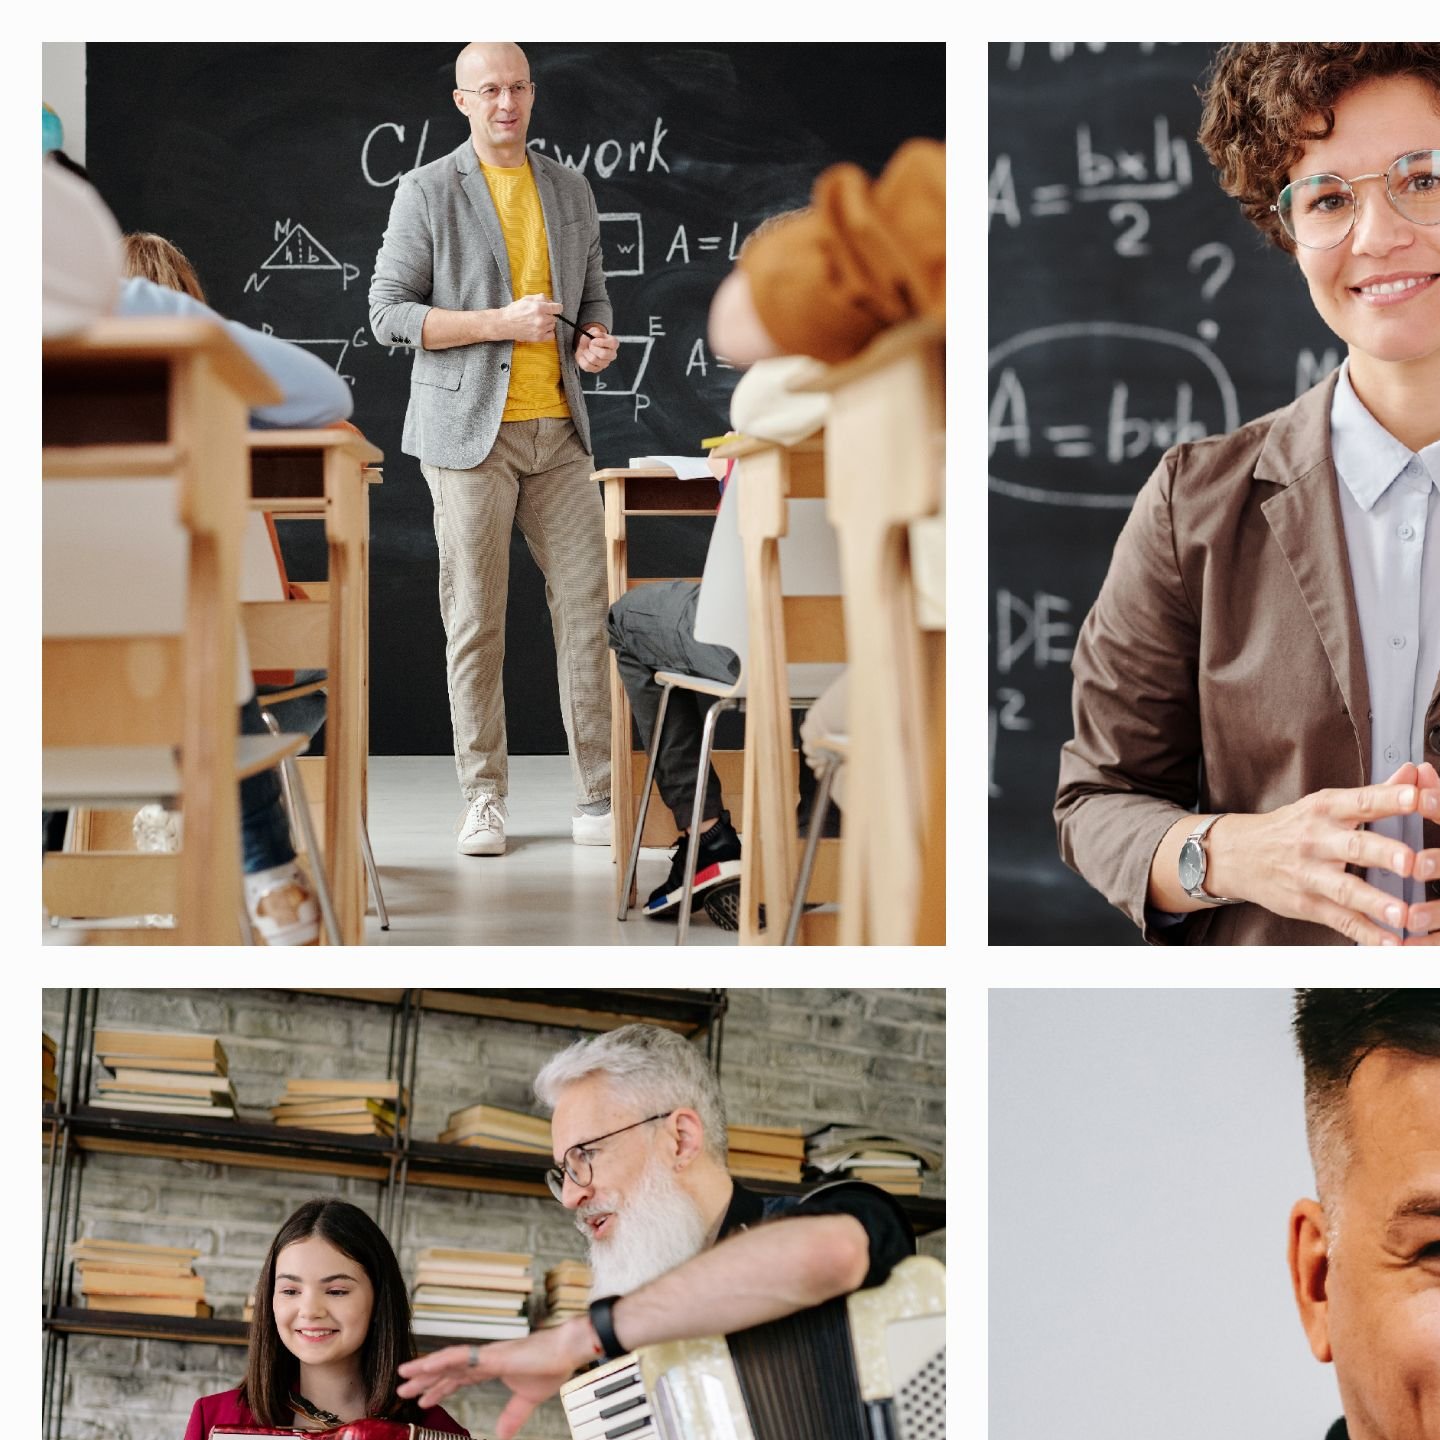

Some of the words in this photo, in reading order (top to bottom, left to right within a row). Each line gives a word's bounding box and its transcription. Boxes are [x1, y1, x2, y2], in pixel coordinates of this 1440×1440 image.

[274, 218, 291, 242] M
[1108, 202, 1151, 257] 2
[244, 272, 271, 293] N
[343, 262, 360, 291] P
[649, 315, 667, 336] E
[633, 393, 650, 423] P
